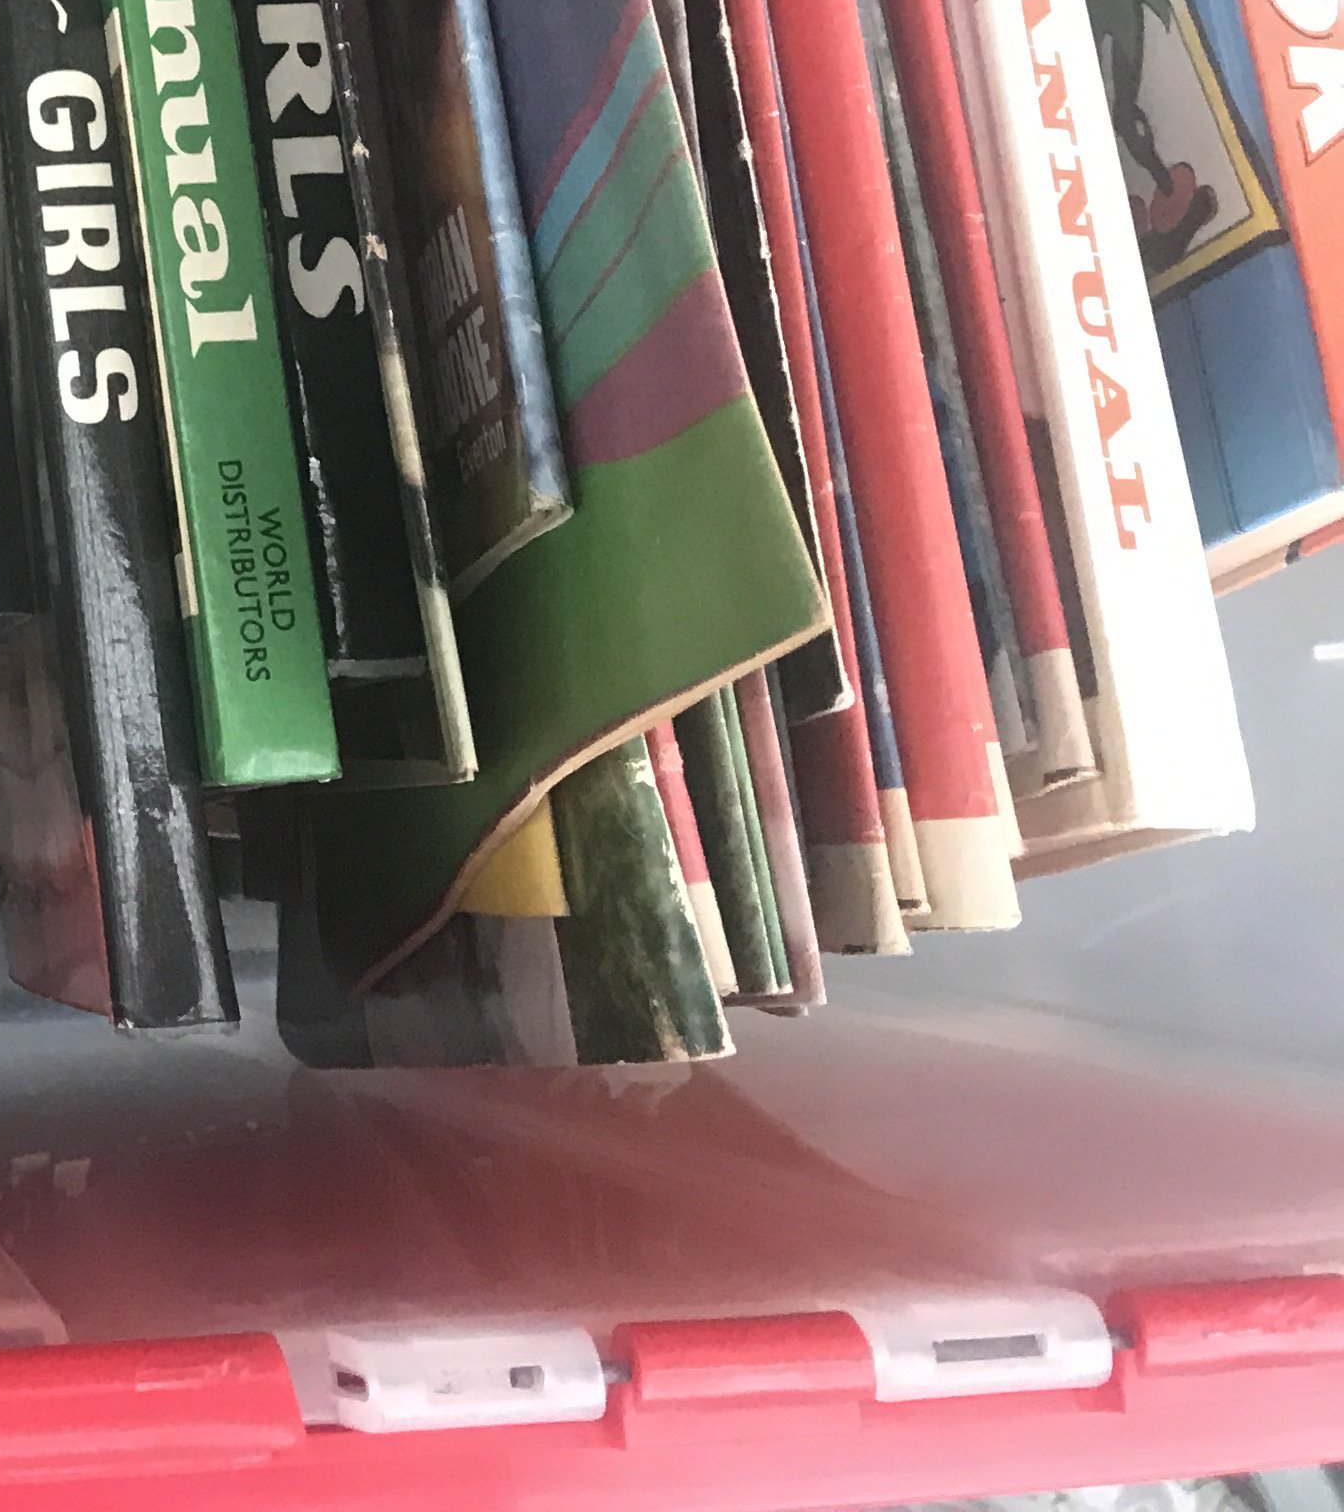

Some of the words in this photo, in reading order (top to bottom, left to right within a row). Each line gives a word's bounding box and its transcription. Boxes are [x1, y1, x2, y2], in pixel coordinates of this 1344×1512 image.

[27, 68, 138, 425] GIRLS
[217, 459, 270, 683] DISTRIBUTORS
[256, 506, 295, 632] WORLD
